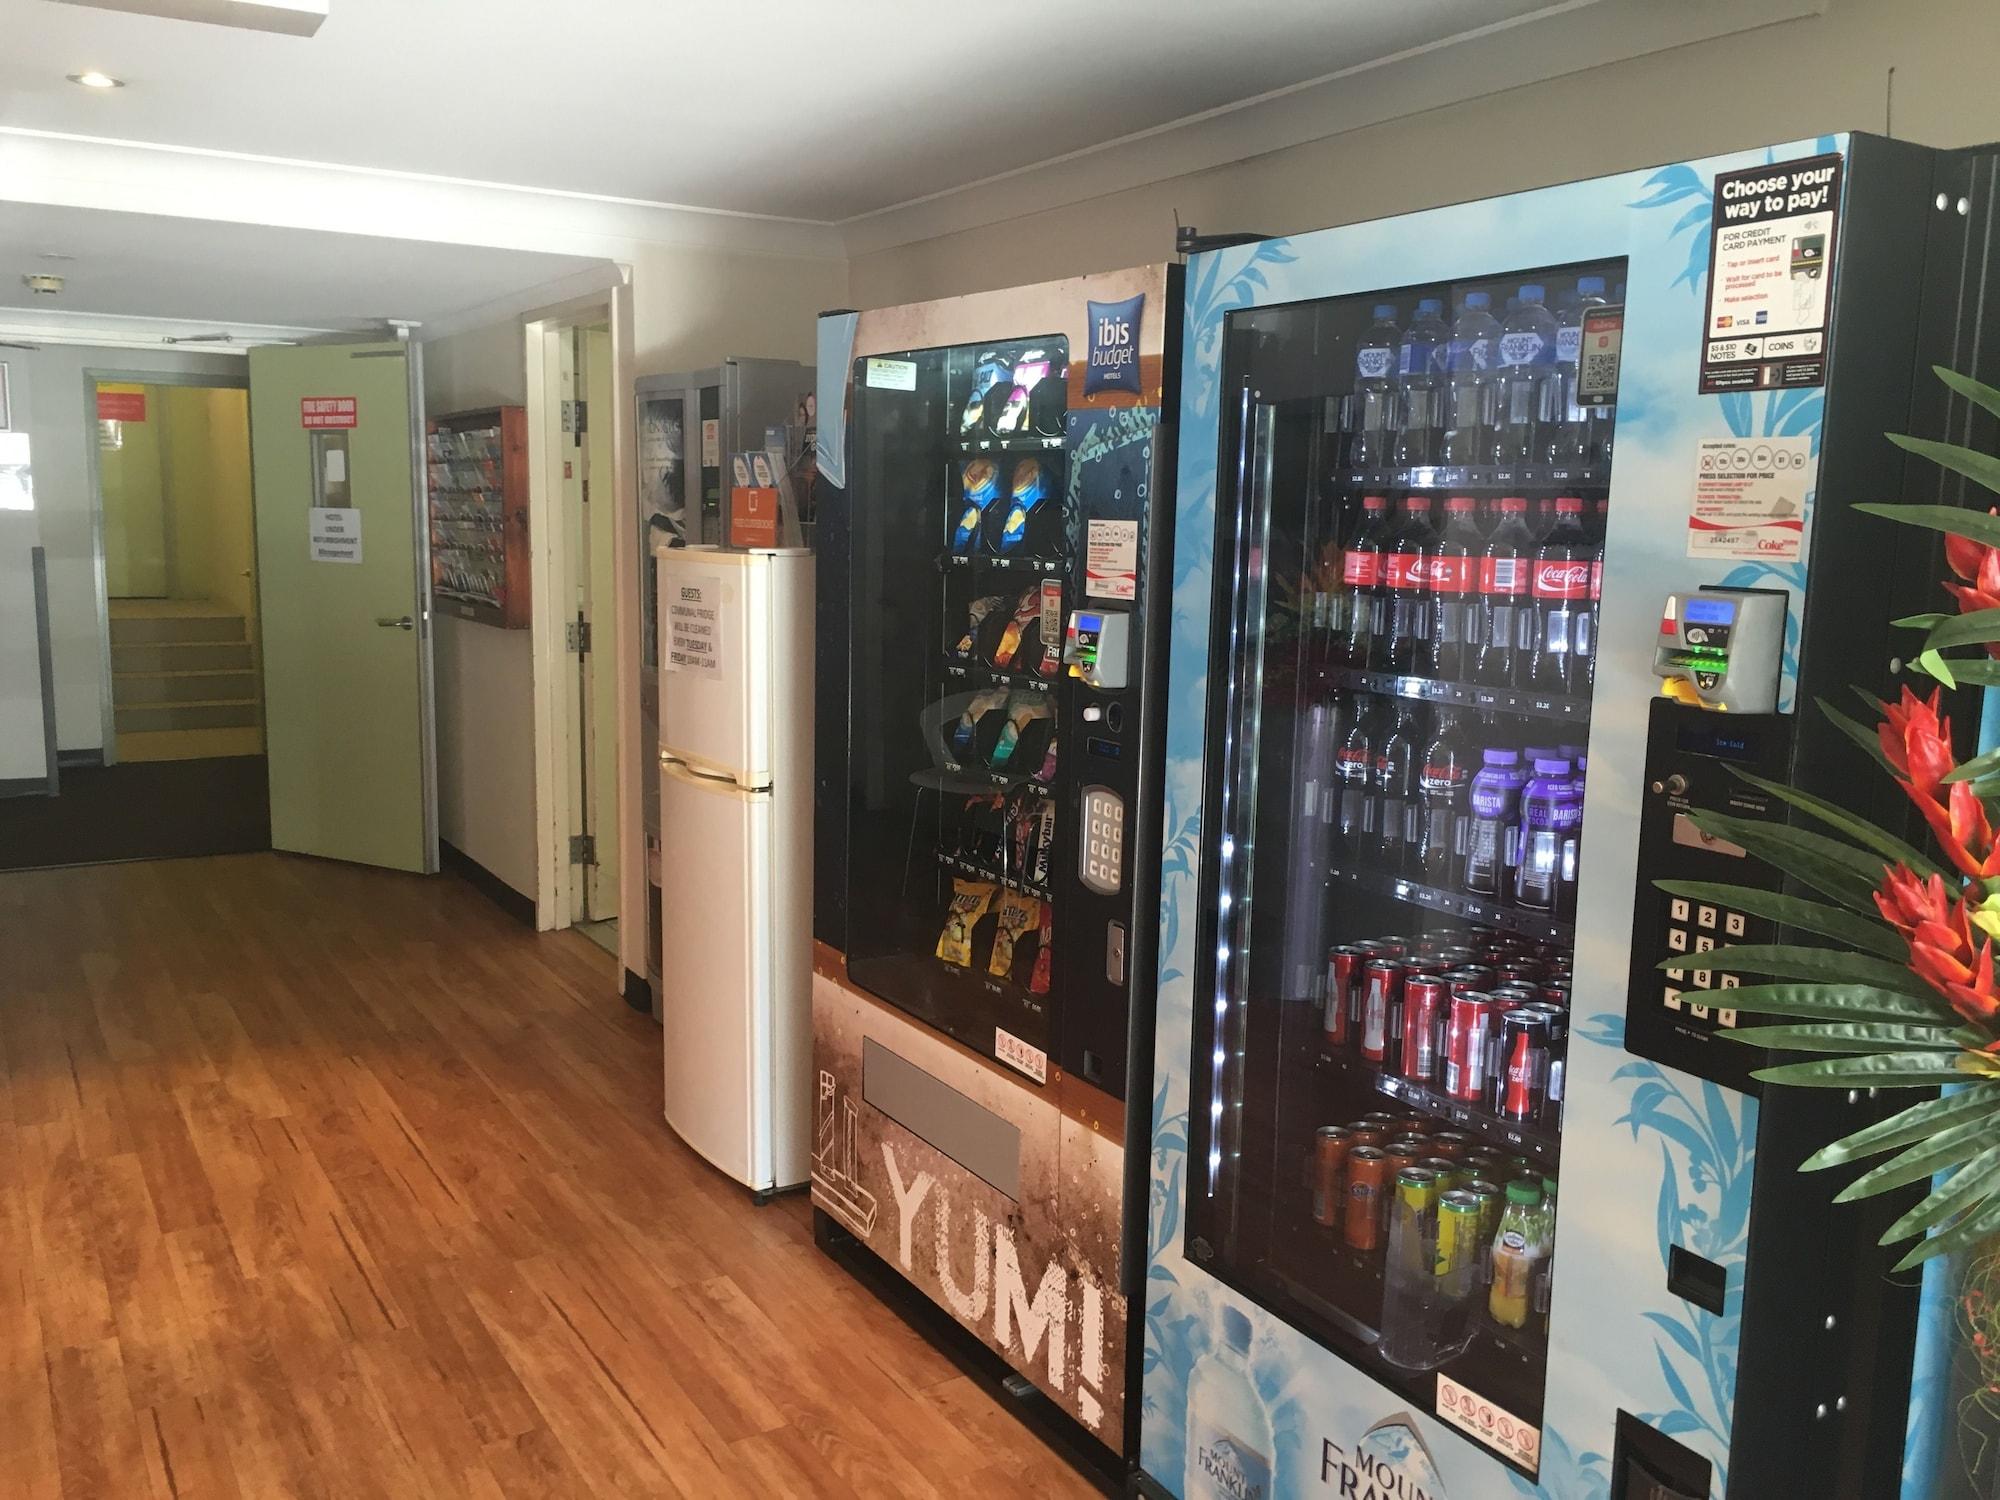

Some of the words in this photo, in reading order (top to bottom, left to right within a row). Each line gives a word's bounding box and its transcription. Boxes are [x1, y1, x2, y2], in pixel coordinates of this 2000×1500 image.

[1722, 175, 1788, 199] Choose
[1791, 167, 1835, 191] your
[1725, 200, 1761, 219] way
[1764, 195, 1784, 212] to
[1787, 185, 1829, 212] pay!
[1723, 232, 1740, 241] FOR
[1741, 227, 1771, 238] CREDIT
[1722, 241, 1745, 251] CARD
[1747, 234, 1787, 248] PAYMENT
[1766, 254, 1780, 262] card
[1098, 316, 1130, 346] ibis
[1501, 342, 1542, 352] FRANKLIN
[1711, 344, 1720, 352] $5
[1726, 343, 1737, 351] $10
[1768, 341, 1794, 351] COINS
[1092, 344, 1134, 370] budget
[1710, 351, 1736, 360] NOTES
[1103, 372, 1121, 380] HOTELS
[1553, 471, 1568, 479] $2.00
[1758, 539, 1784, 550] Coke
[1540, 565, 1589, 584] Coca-Cola
[1344, 760, 1364, 769] zero
[1429, 778, 1452, 787] zero
[1473, 794, 1501, 808] BARISTA
[1678, 904, 1684, 915] 1
[1704, 911, 1712, 923] 2
[1732, 919, 1740, 930] 3
[1674, 934, 1682, 945] 4
[1701, 942, 1709, 952] 5
[1699, 971, 1707, 983] 8
[1727, 980, 1734, 989] 9
[1507, 1132, 1522, 1143] $2.00
[880, 1141, 1104, 1430] YUM!
